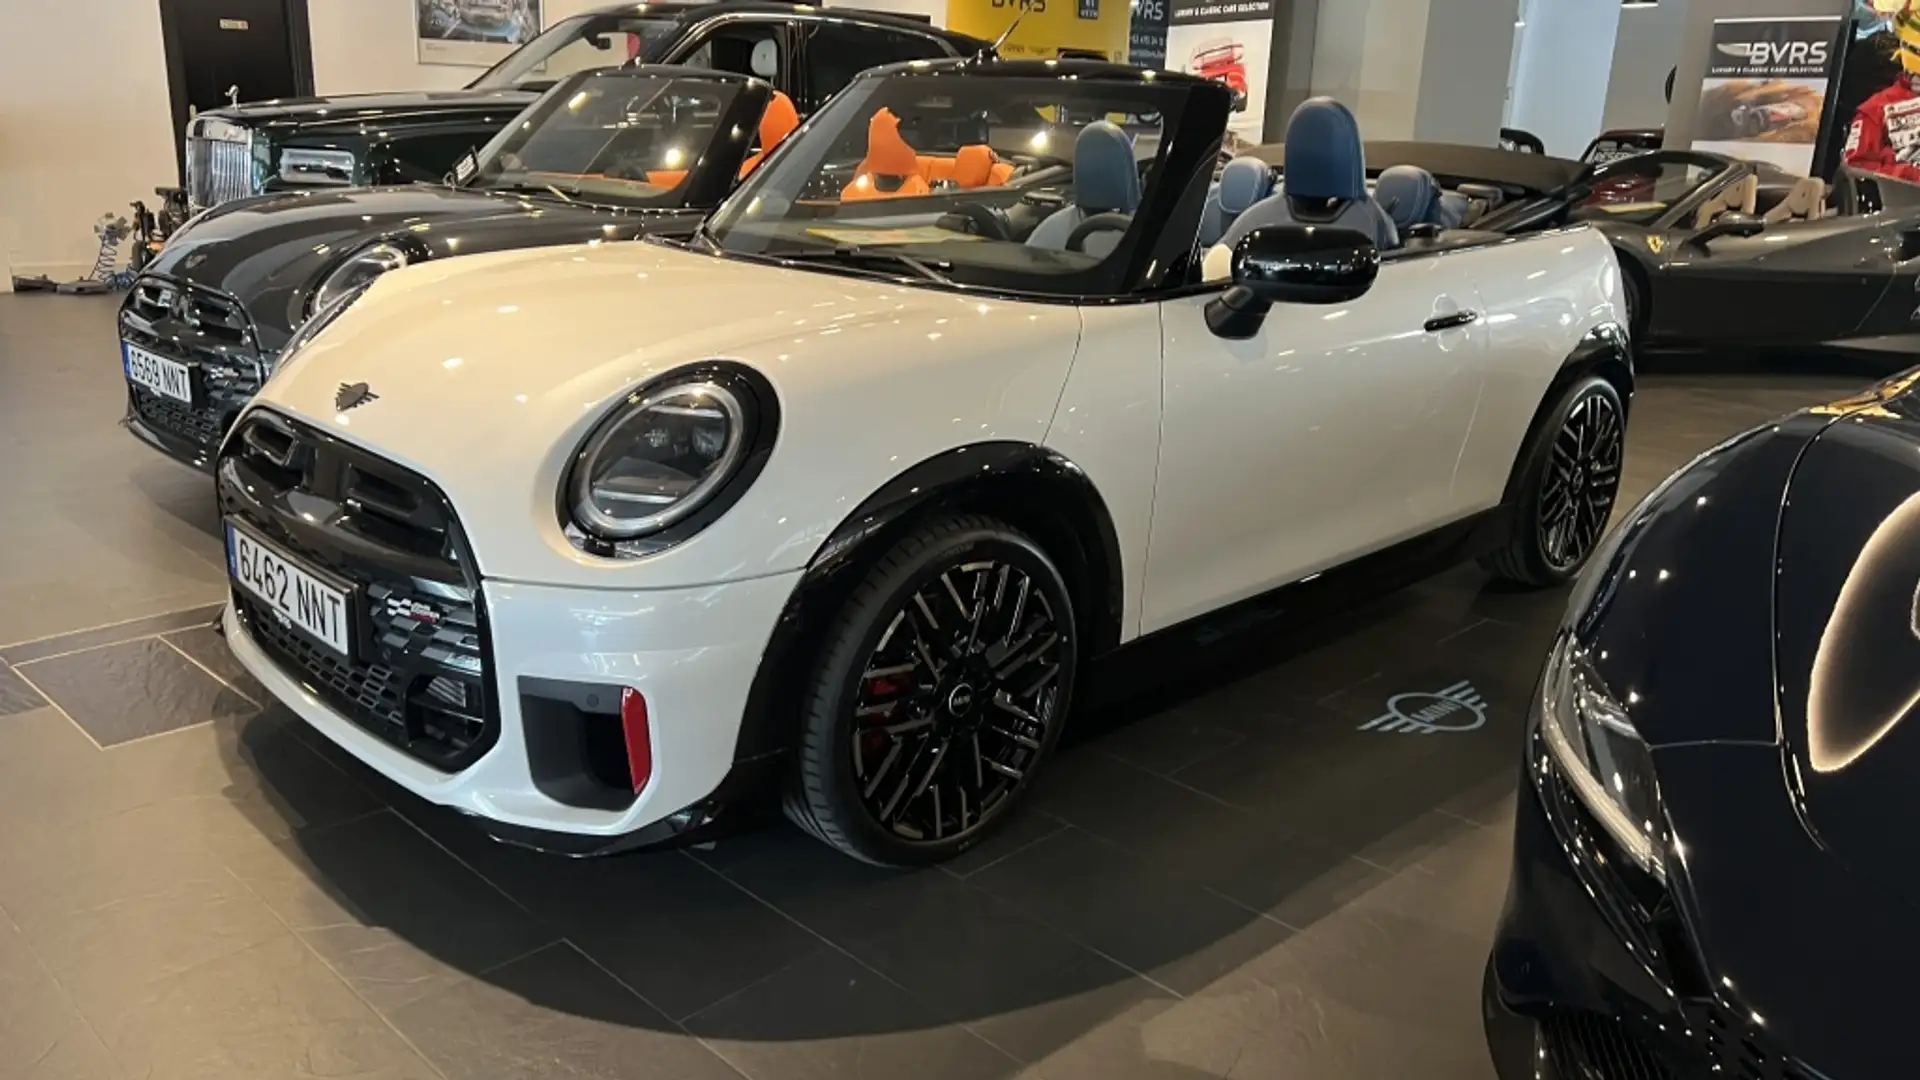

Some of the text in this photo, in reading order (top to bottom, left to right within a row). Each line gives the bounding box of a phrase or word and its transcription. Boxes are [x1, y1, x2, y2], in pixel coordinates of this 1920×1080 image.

[1750, 41, 1829, 65] BVRS
[162, 362, 187, 399] NNT
[239, 538, 340, 644] 6462 NNT
